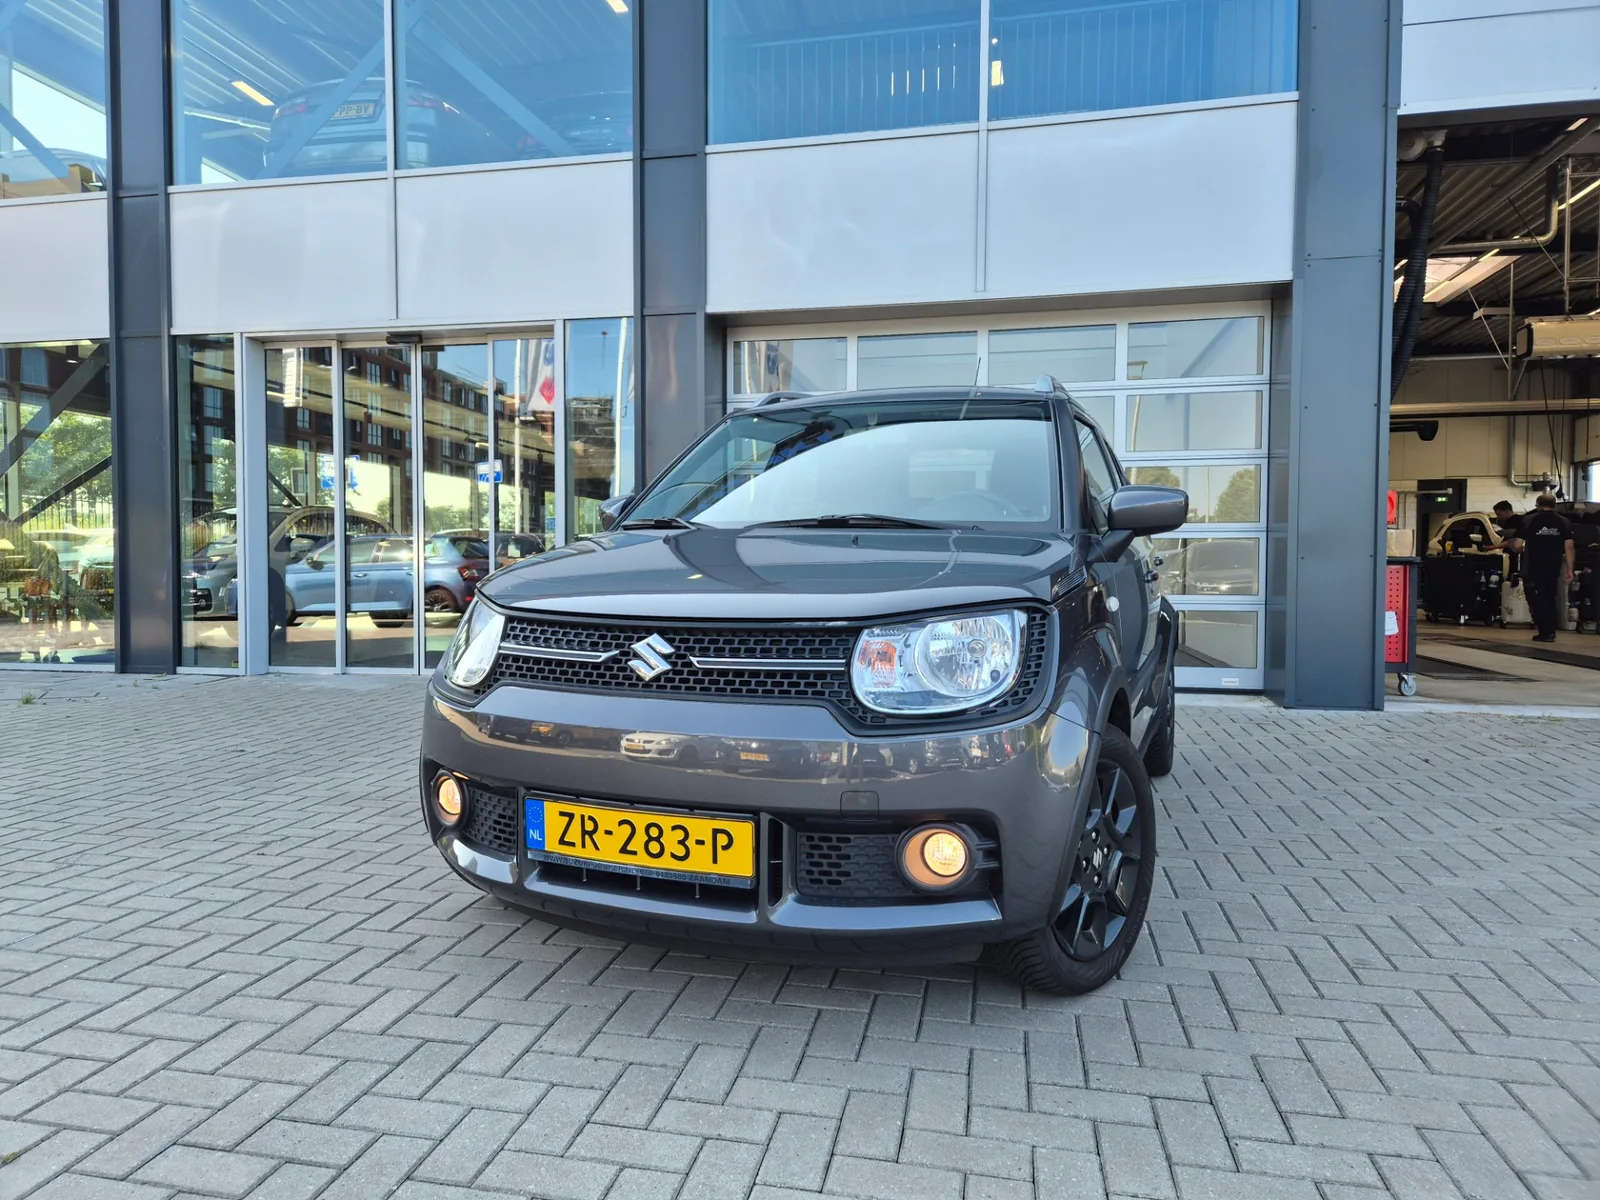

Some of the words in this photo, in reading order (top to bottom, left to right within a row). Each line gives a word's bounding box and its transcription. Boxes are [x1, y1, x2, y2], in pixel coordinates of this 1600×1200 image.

[529, 828, 543, 842] NL
[558, 810, 735, 865] ZR-283-P
[688, 872, 731, 886] ZAANDAM
